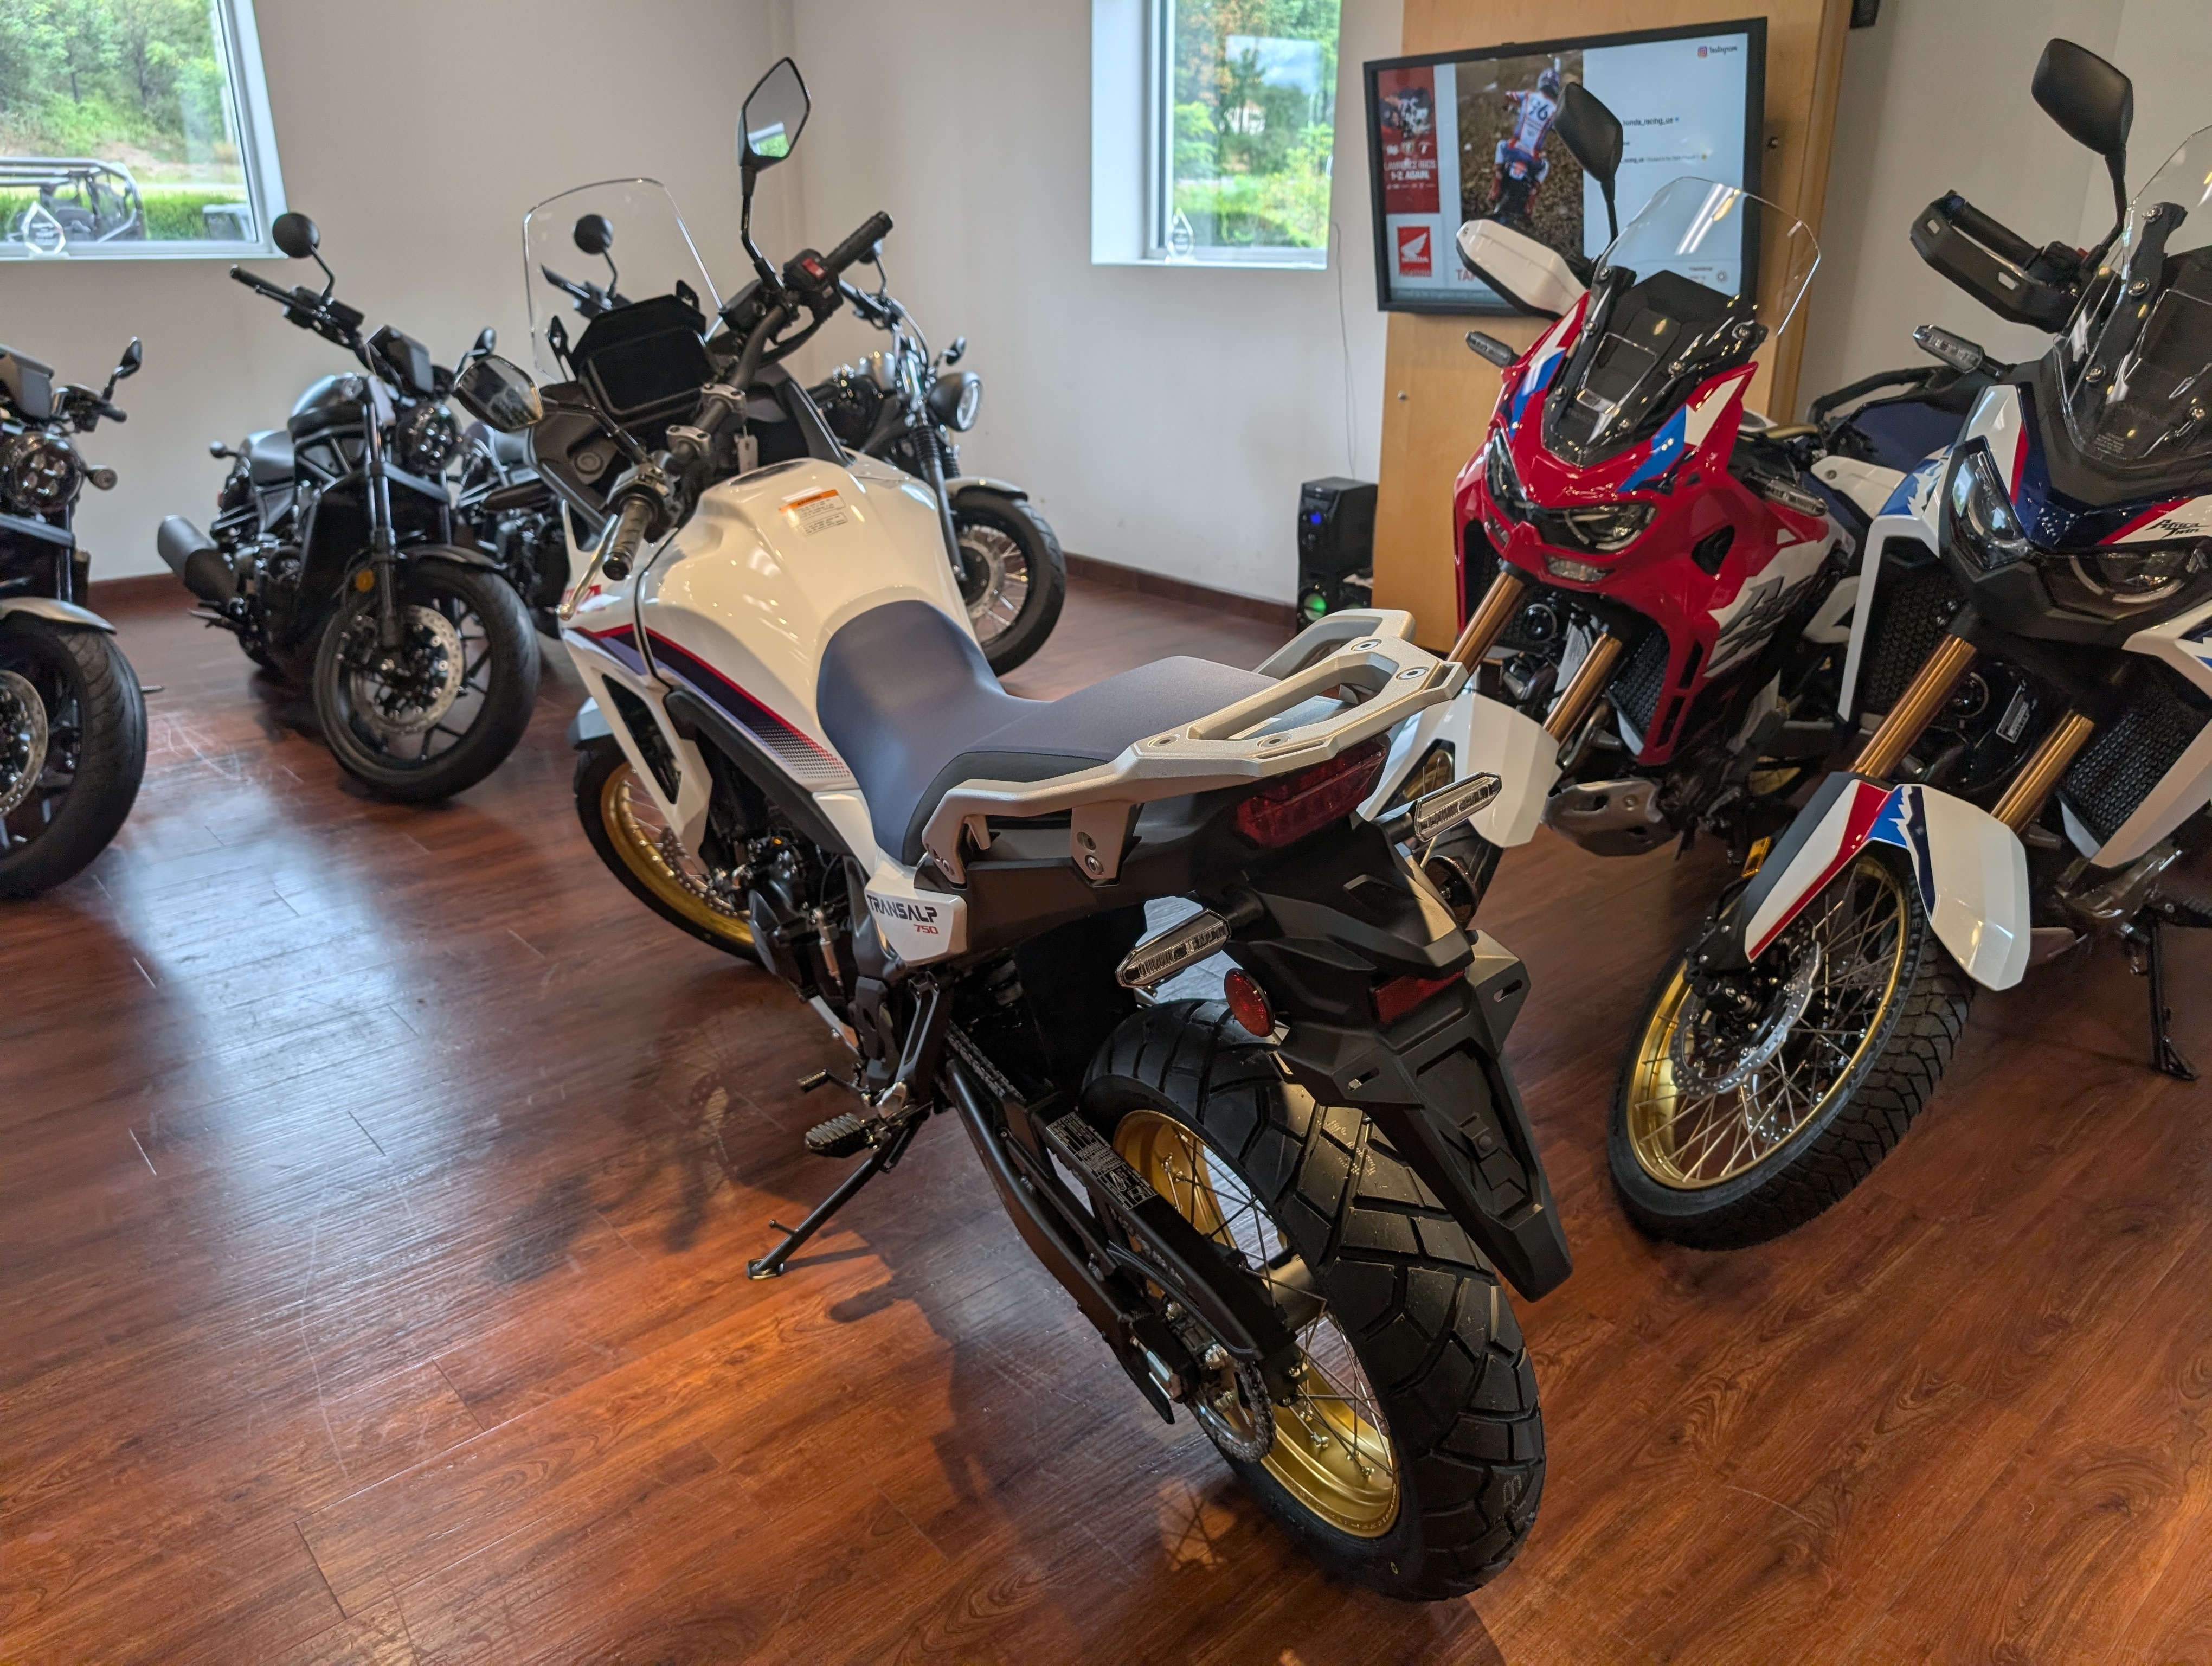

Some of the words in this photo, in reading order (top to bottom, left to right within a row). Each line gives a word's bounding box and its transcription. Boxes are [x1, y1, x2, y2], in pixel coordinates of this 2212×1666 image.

[1709, 46, 1737, 55] Instagram
[2145, 519, 2210, 531] Africa
[2160, 528, 2205, 539] Twin
[867, 894, 937, 923] TRANSALP
[914, 924, 938, 934] 750
[1901, 872, 1923, 978] ICHELIN
